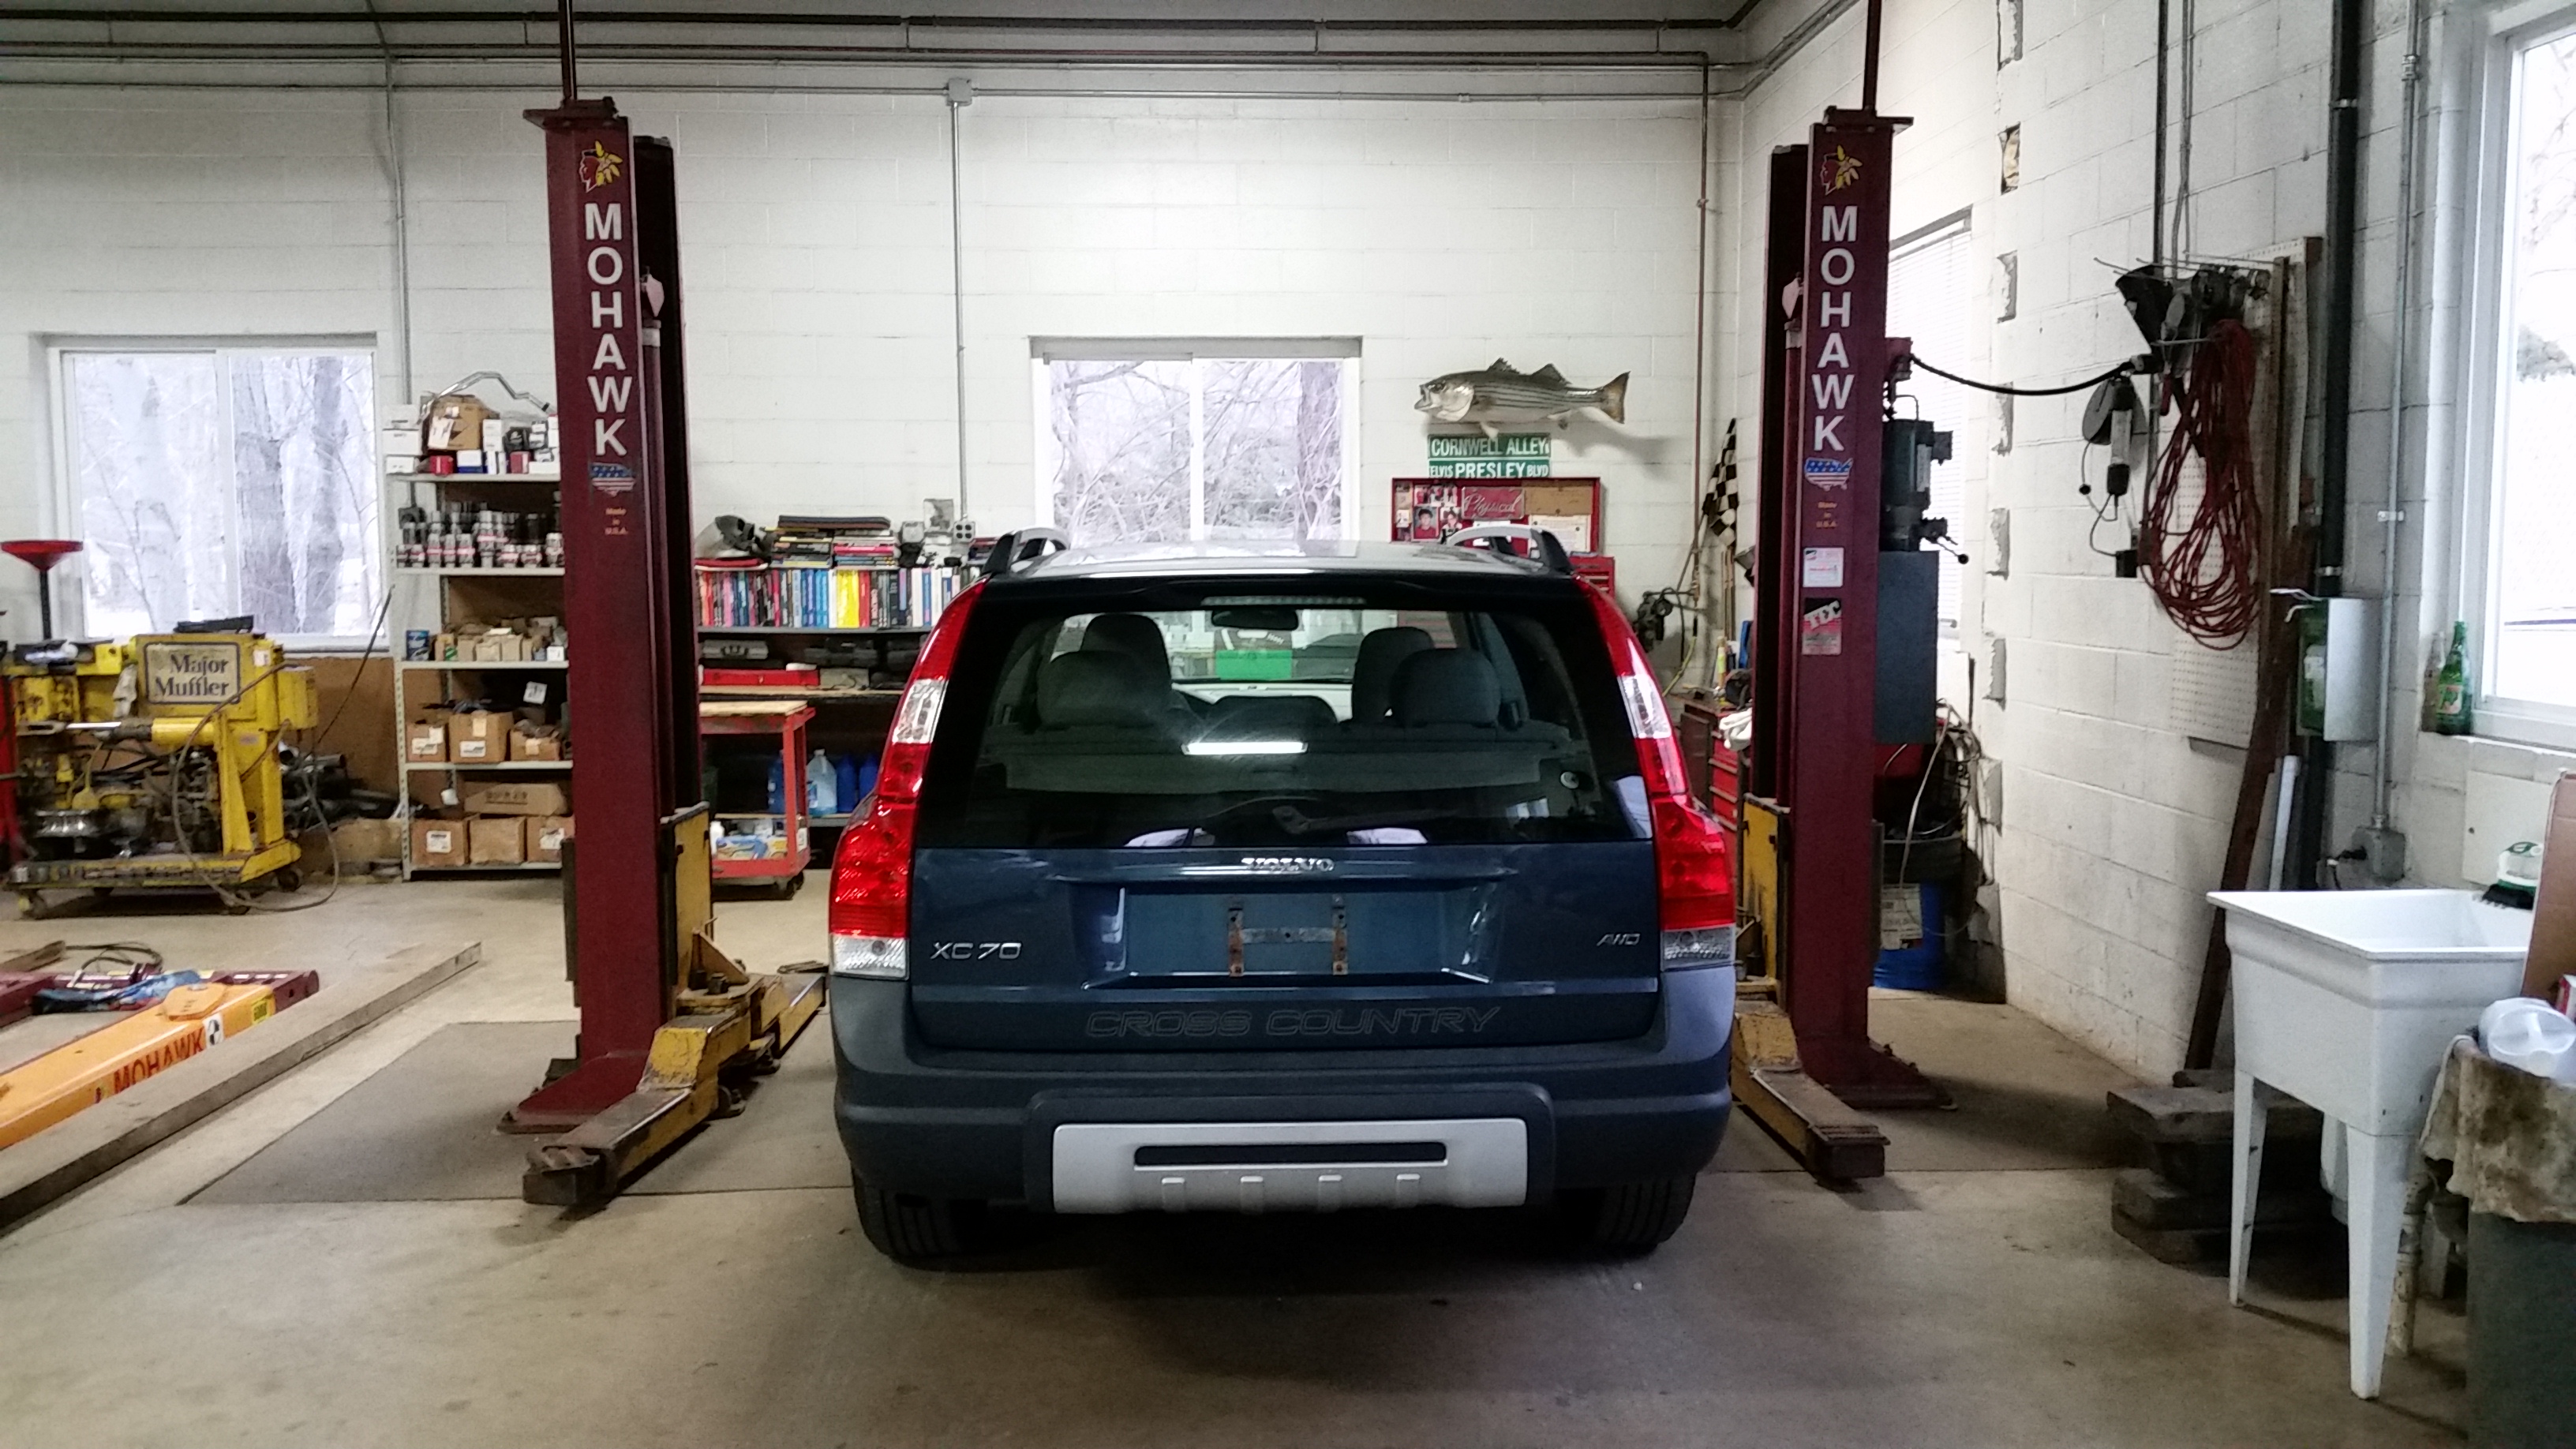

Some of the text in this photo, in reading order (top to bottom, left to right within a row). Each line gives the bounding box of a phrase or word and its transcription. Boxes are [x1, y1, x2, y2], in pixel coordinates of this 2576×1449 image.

[584, 202, 633, 458] MOHAWK
[1811, 204, 1858, 452] MOHAWK
[1431, 438, 1503, 457] CORNWELL
[1506, 437, 1547, 455] ALLEY
[1429, 462, 1548, 479] ELVIS PRESLEY BLVD
[170, 653, 229, 676] Major
[155, 676, 230, 696] Muffler
[1085, 1005, 1502, 1038] CROSS COUNTRY
[113, 1026, 206, 1095] MOHAWK
